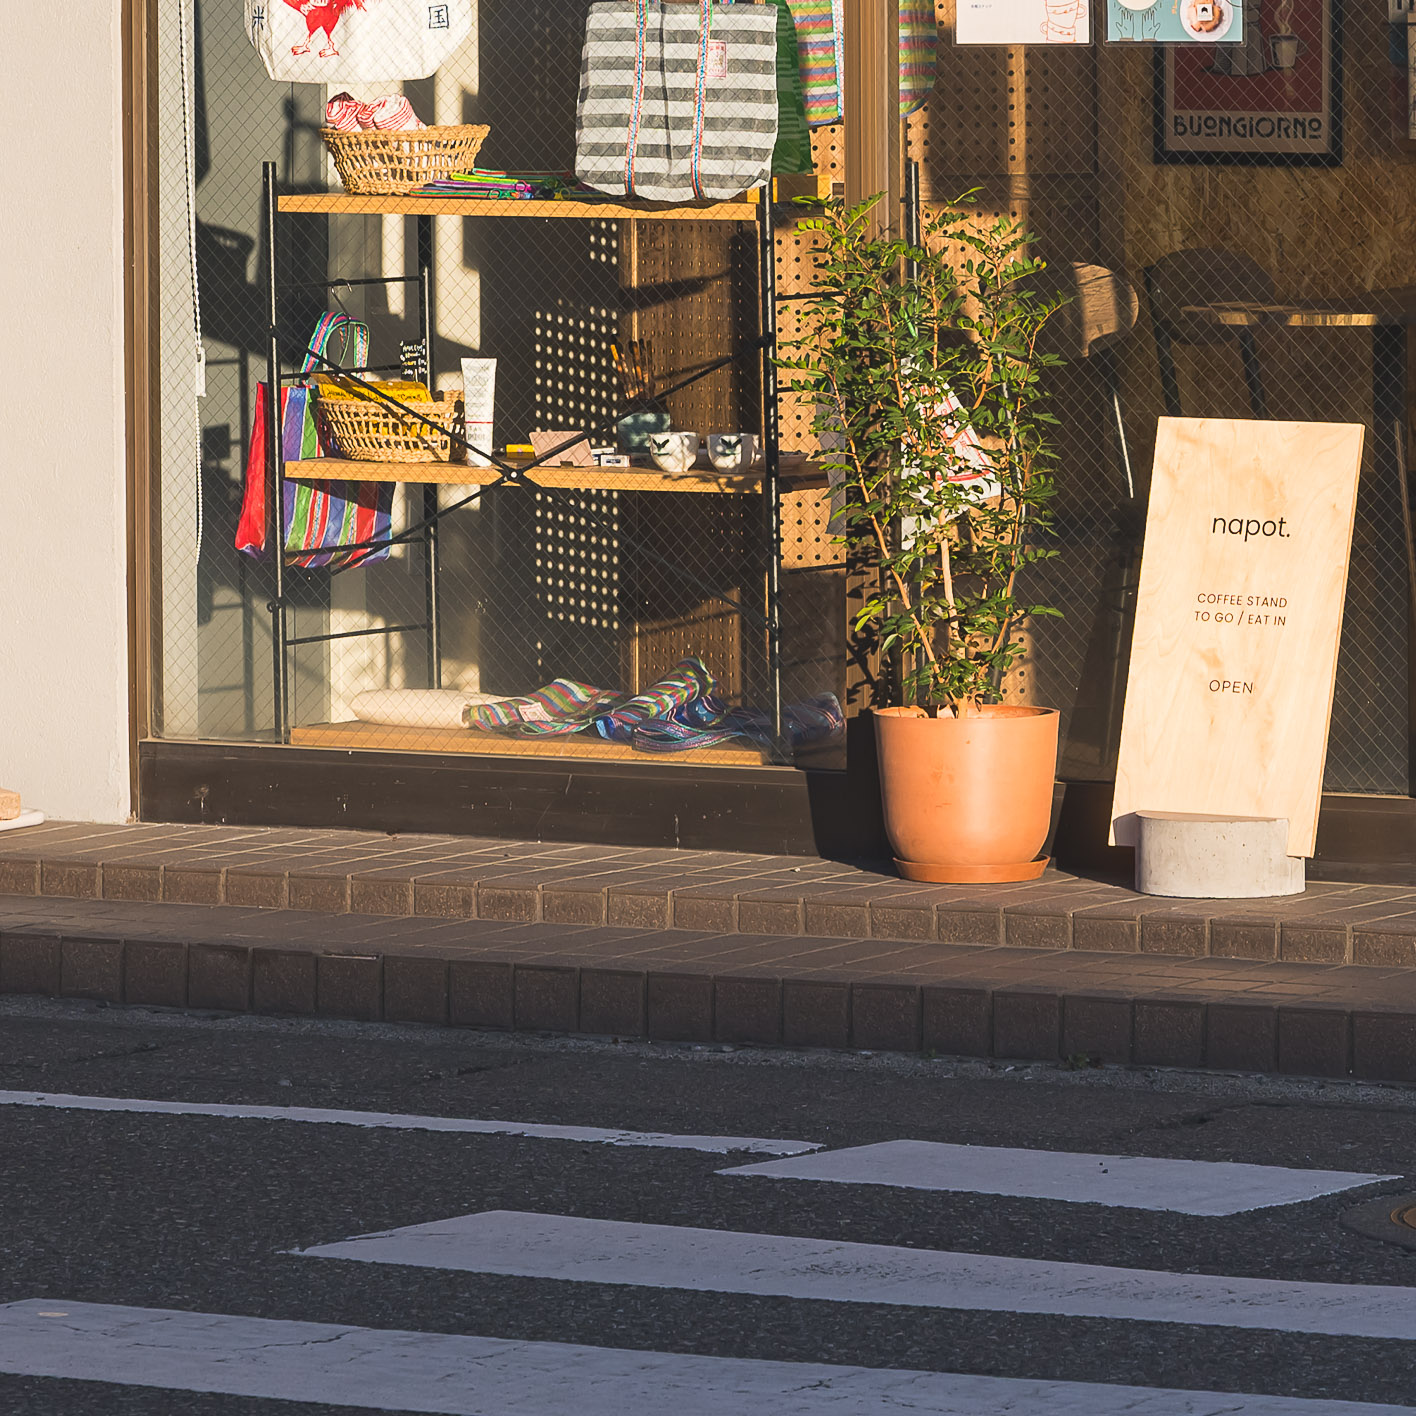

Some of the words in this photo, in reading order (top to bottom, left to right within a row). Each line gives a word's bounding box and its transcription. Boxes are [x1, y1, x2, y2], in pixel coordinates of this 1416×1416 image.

[1173, 115, 1323, 139] BUONGIORNO
[1212, 517, 1291, 542] napot.
[1197, 593, 1242, 605] COFFEE
[1247, 595, 1288, 608] STAND
[1194, 610, 1210, 622] TO
[1214, 611, 1234, 623] GO
[1237, 610, 1245, 626] /
[1247, 614, 1270, 626] EAT
[1273, 615, 1286, 627] IN
[1209, 679, 1254, 694] OPEN
